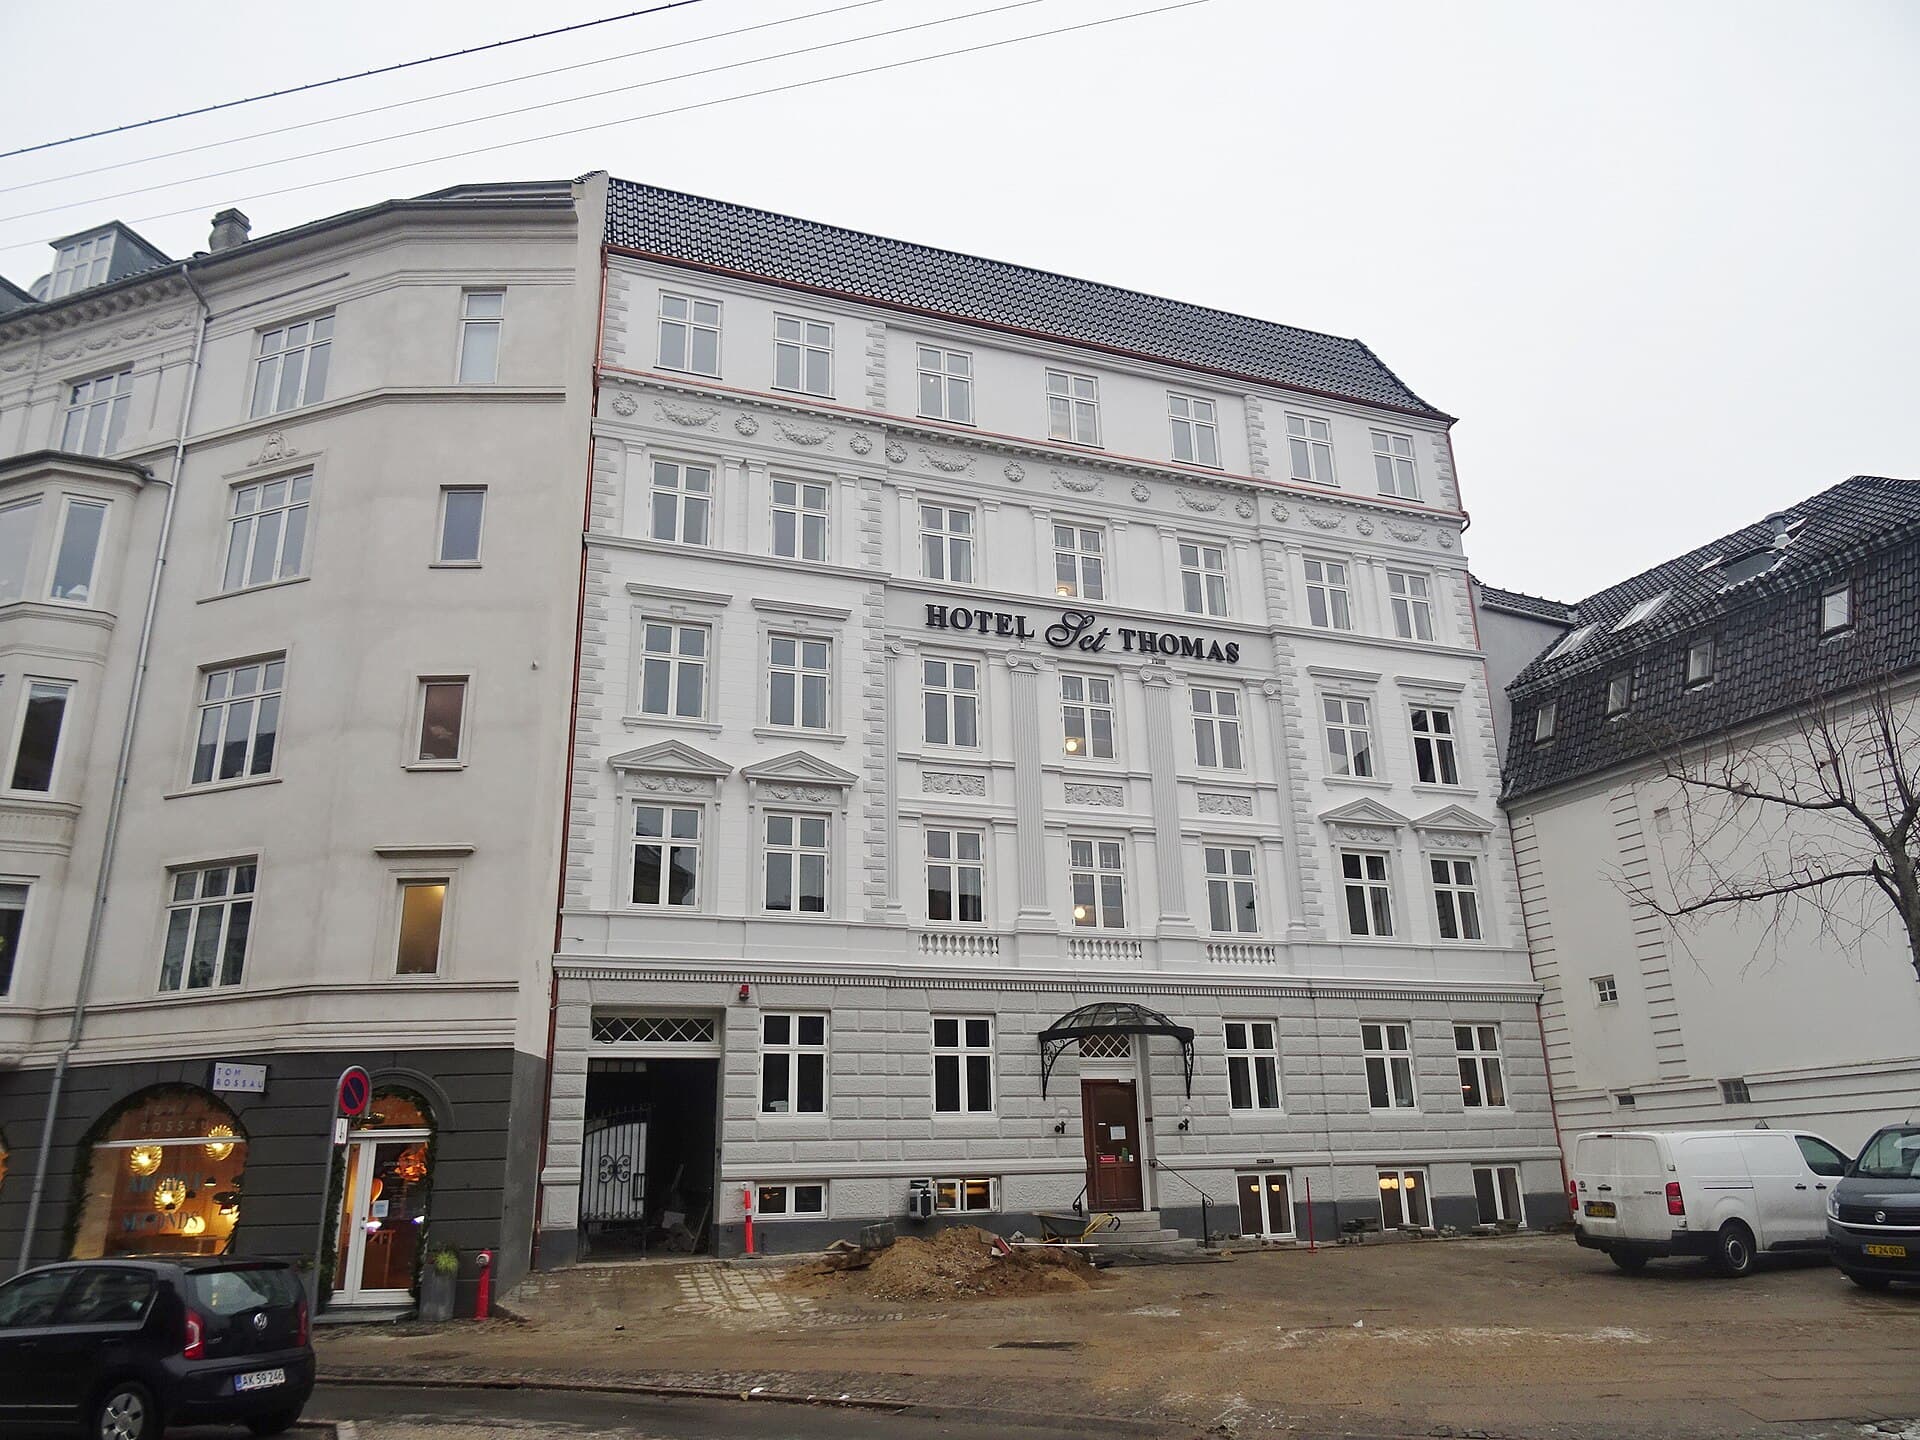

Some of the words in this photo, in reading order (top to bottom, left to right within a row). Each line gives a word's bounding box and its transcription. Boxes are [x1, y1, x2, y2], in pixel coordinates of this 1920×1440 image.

[925, 603, 1036, 638] HOTEL
[1045, 611, 1111, 652] Sct
[1118, 627, 1240, 664] THOMAS
[217, 1067, 242, 1077] TOM
[216, 1078, 264, 1089] ROSSAU
[139, 1120, 209, 1133] ROSSAU
[256, 1372, 267, 1384] 59
